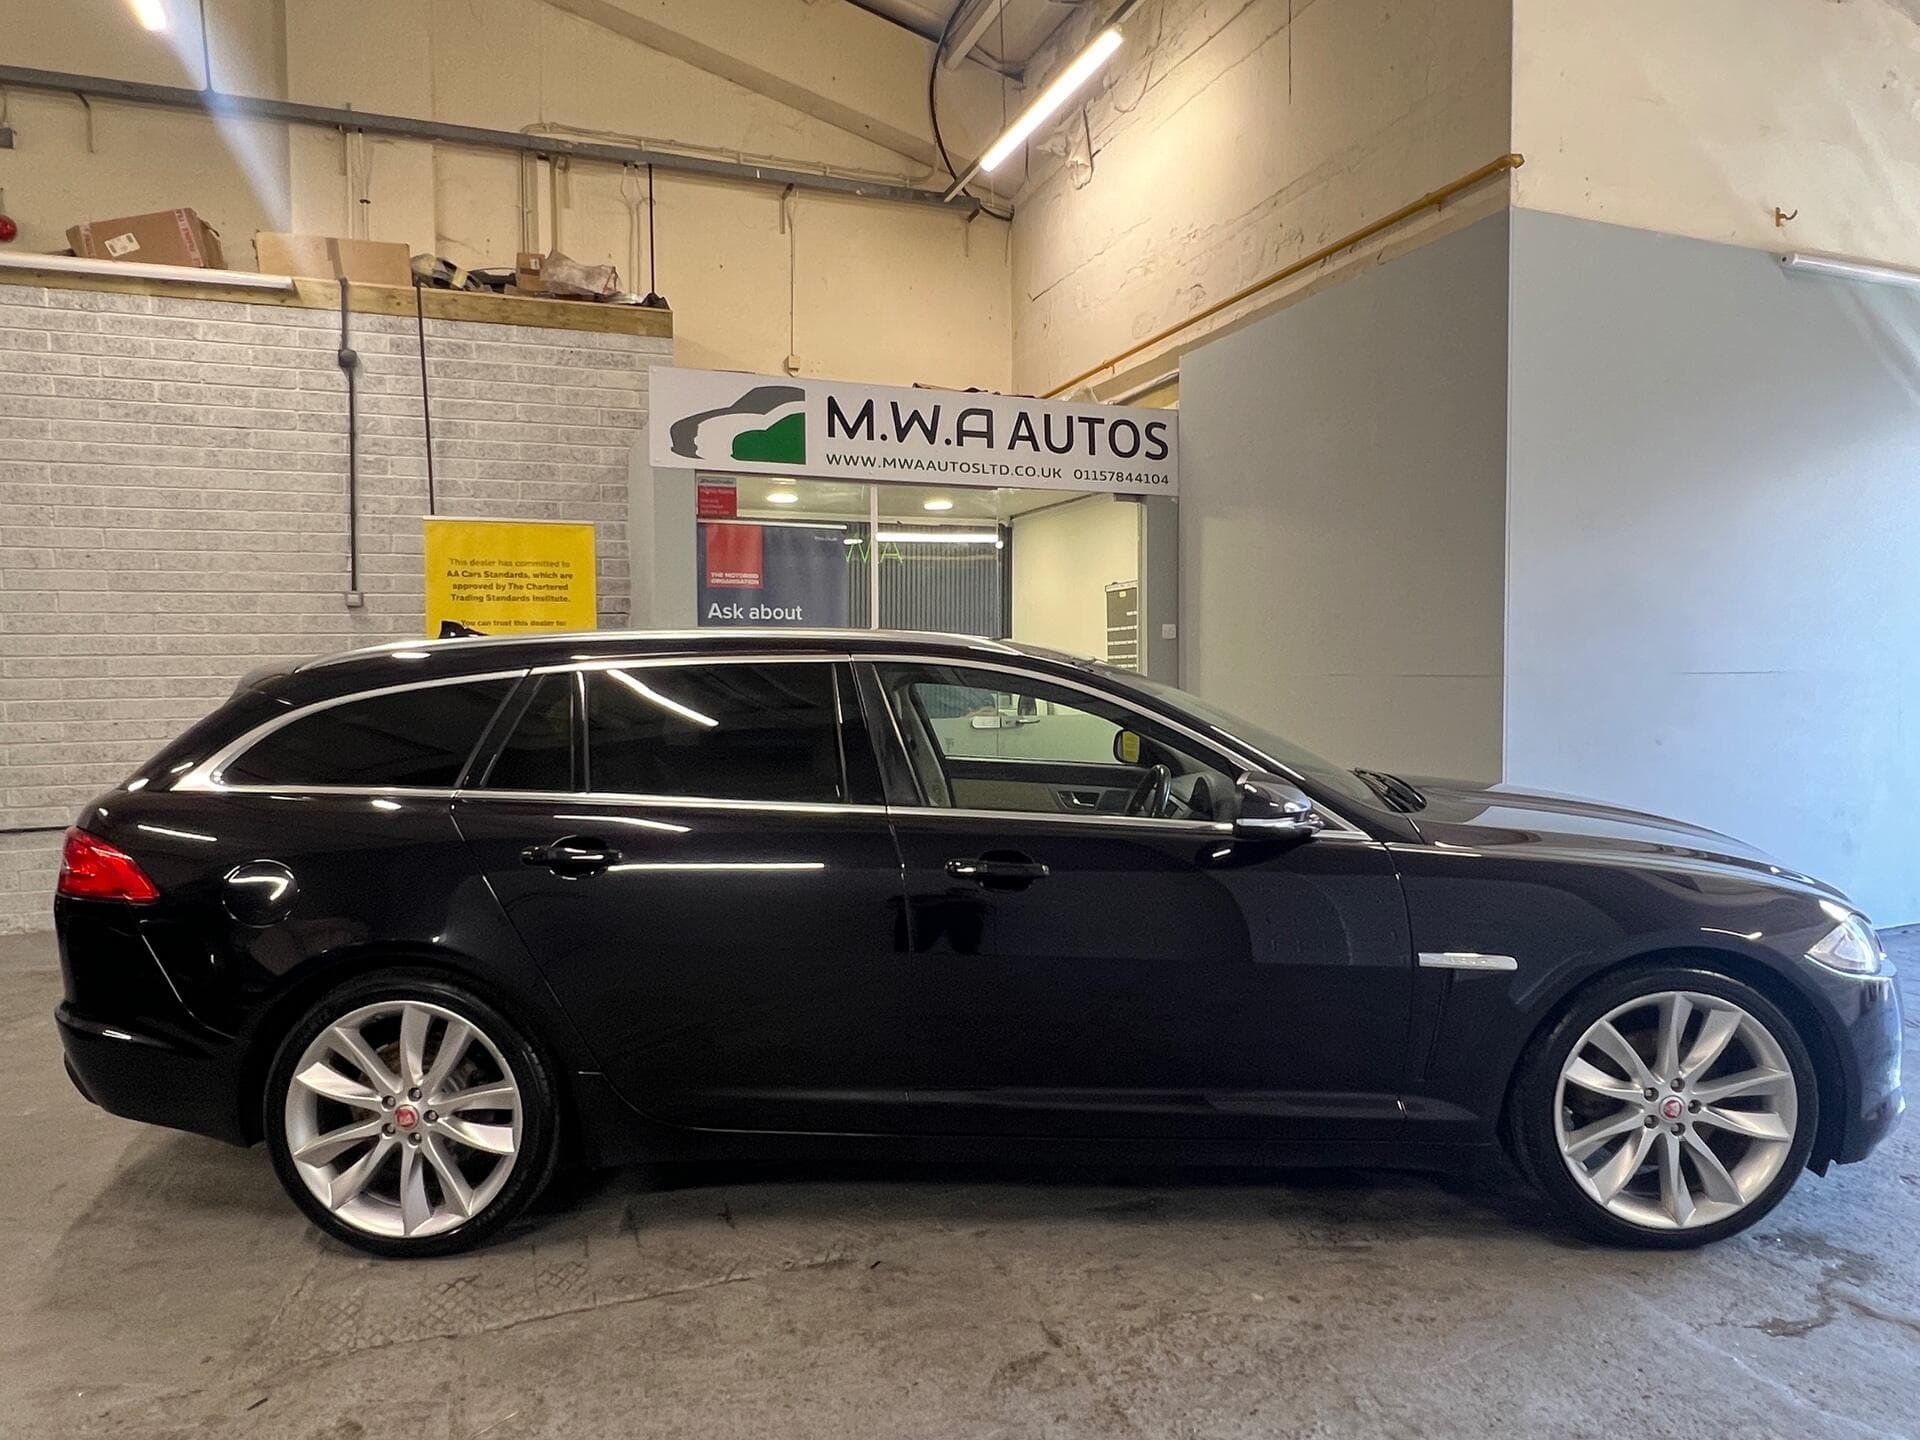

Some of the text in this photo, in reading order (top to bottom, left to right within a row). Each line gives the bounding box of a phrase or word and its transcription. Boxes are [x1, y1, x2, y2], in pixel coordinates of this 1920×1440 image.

[1007, 411, 1169, 461] AUTOS
[826, 453, 1170, 485] WWW.MWAAUTOSLTD.CO.UK 01157844104
[449, 558, 570, 568] This dealer has committed to
[447, 570, 459, 578] AA
[462, 570, 482, 578] Cars
[483, 570, 530, 579] Standards,
[532, 571, 558, 580] which
[452, 583, 569, 592] approved by The Chartered
[451, 594, 484, 603] Trading
[486, 594, 530, 602] Standards
[708, 603, 803, 620] Ask about
[514, 619, 528, 627] this
[531, 619, 554, 627] dealer
